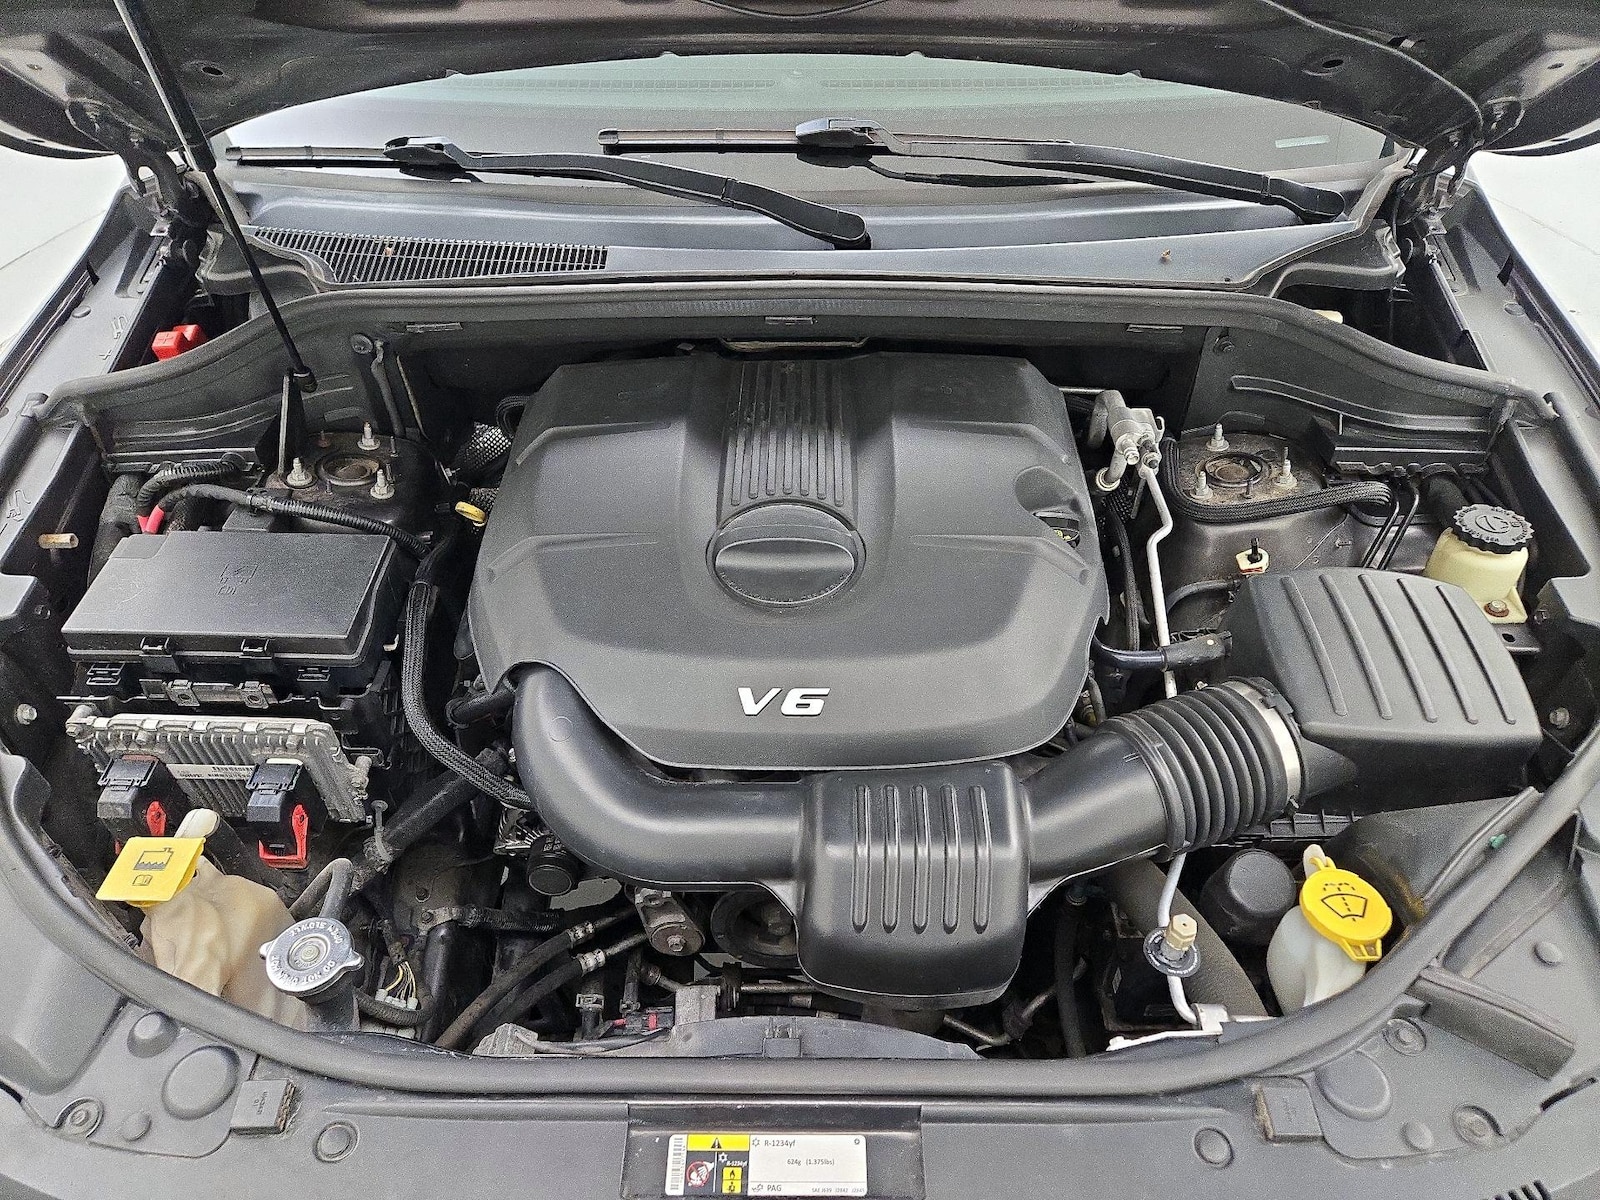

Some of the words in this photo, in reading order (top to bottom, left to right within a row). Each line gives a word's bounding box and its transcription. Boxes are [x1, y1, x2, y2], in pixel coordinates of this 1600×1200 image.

[738, 687, 831, 717] V6
[764, 1139, 796, 1150] R-1234yf
[787, 1158, 802, 1167] 624g
[805, 1158, 835, 1167] (1.375lbs)
[767, 1184, 782, 1193] PAG
